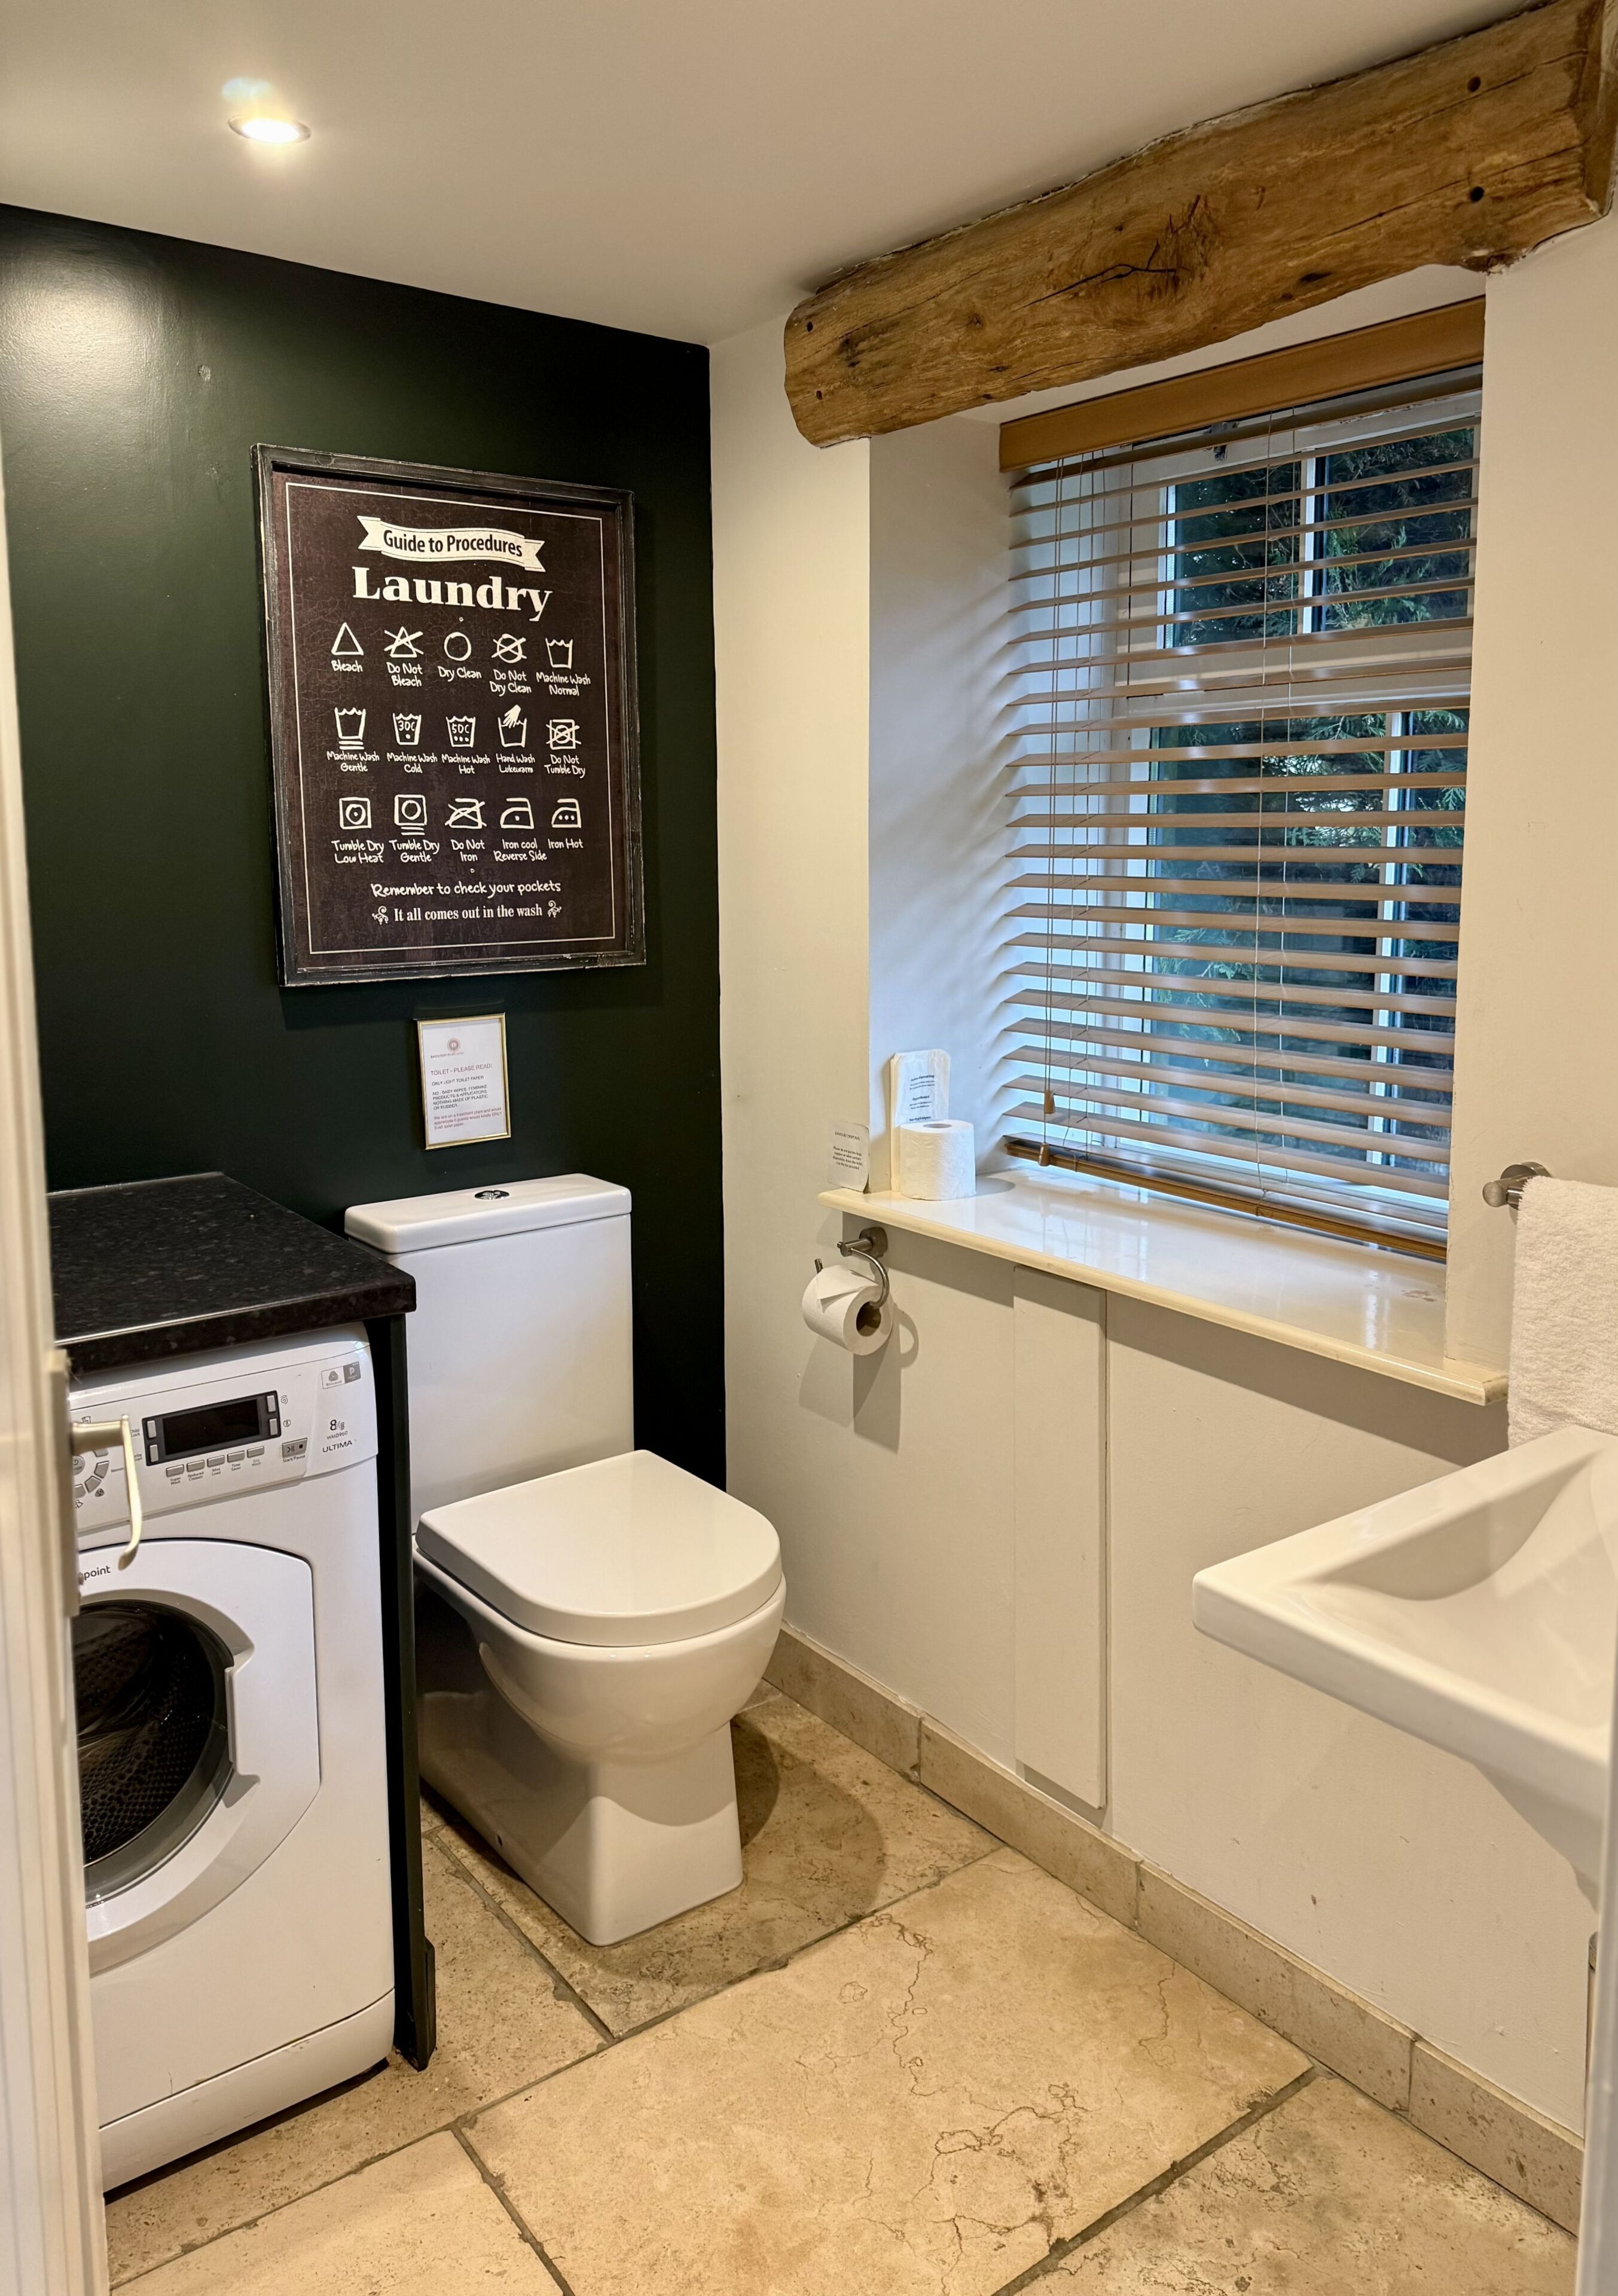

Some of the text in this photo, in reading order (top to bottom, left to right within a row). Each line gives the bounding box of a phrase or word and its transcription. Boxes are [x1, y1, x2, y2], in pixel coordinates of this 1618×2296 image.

[383, 530, 523, 557] Guide to Procedures
[352, 566, 553, 622] Laundry
[331, 659, 363, 672] Bleach
[386, 661, 423, 674] Do Not
[438, 665, 482, 682] Dry Clean
[493, 668, 527, 681] Do Not
[536, 671, 591, 685] Machine Wash
[391, 674, 422, 687] Bleach
[489, 681, 532, 697] Dry Clean
[549, 685, 579, 696] Normal
[326, 750, 380, 762] Machine Wash
[386, 752, 438, 763] Machine Wash
[441, 753, 490, 764] Machine Wash
[496, 753, 535, 764] Hand Wash
[550, 754, 579, 765] Do Not
[340, 762, 368, 772] Gentle
[404, 763, 423, 774] Cold
[459, 765, 475, 775] Hot
[544, 764, 585, 778] Tumble Dry
[331, 839, 384, 855] Tumble Dry
[389, 839, 440, 854] Tumble Dry
[451, 839, 486, 850] Do Not
[502, 838, 538, 850] Iron cool
[548, 838, 584, 849] Iron Hot
[334, 853, 384, 864] Low Heat
[400, 851, 432, 863] Gentle
[460, 851, 478, 862] Iron
[493, 850, 547, 862] Reverse Side
[370, 880, 561, 899] Remember to check your pockets
[394, 903, 543, 922] It all comes out in the wash
[454, 1065, 475, 1073] PLEASE
[322, 1440, 353, 1452] ULTIMA
